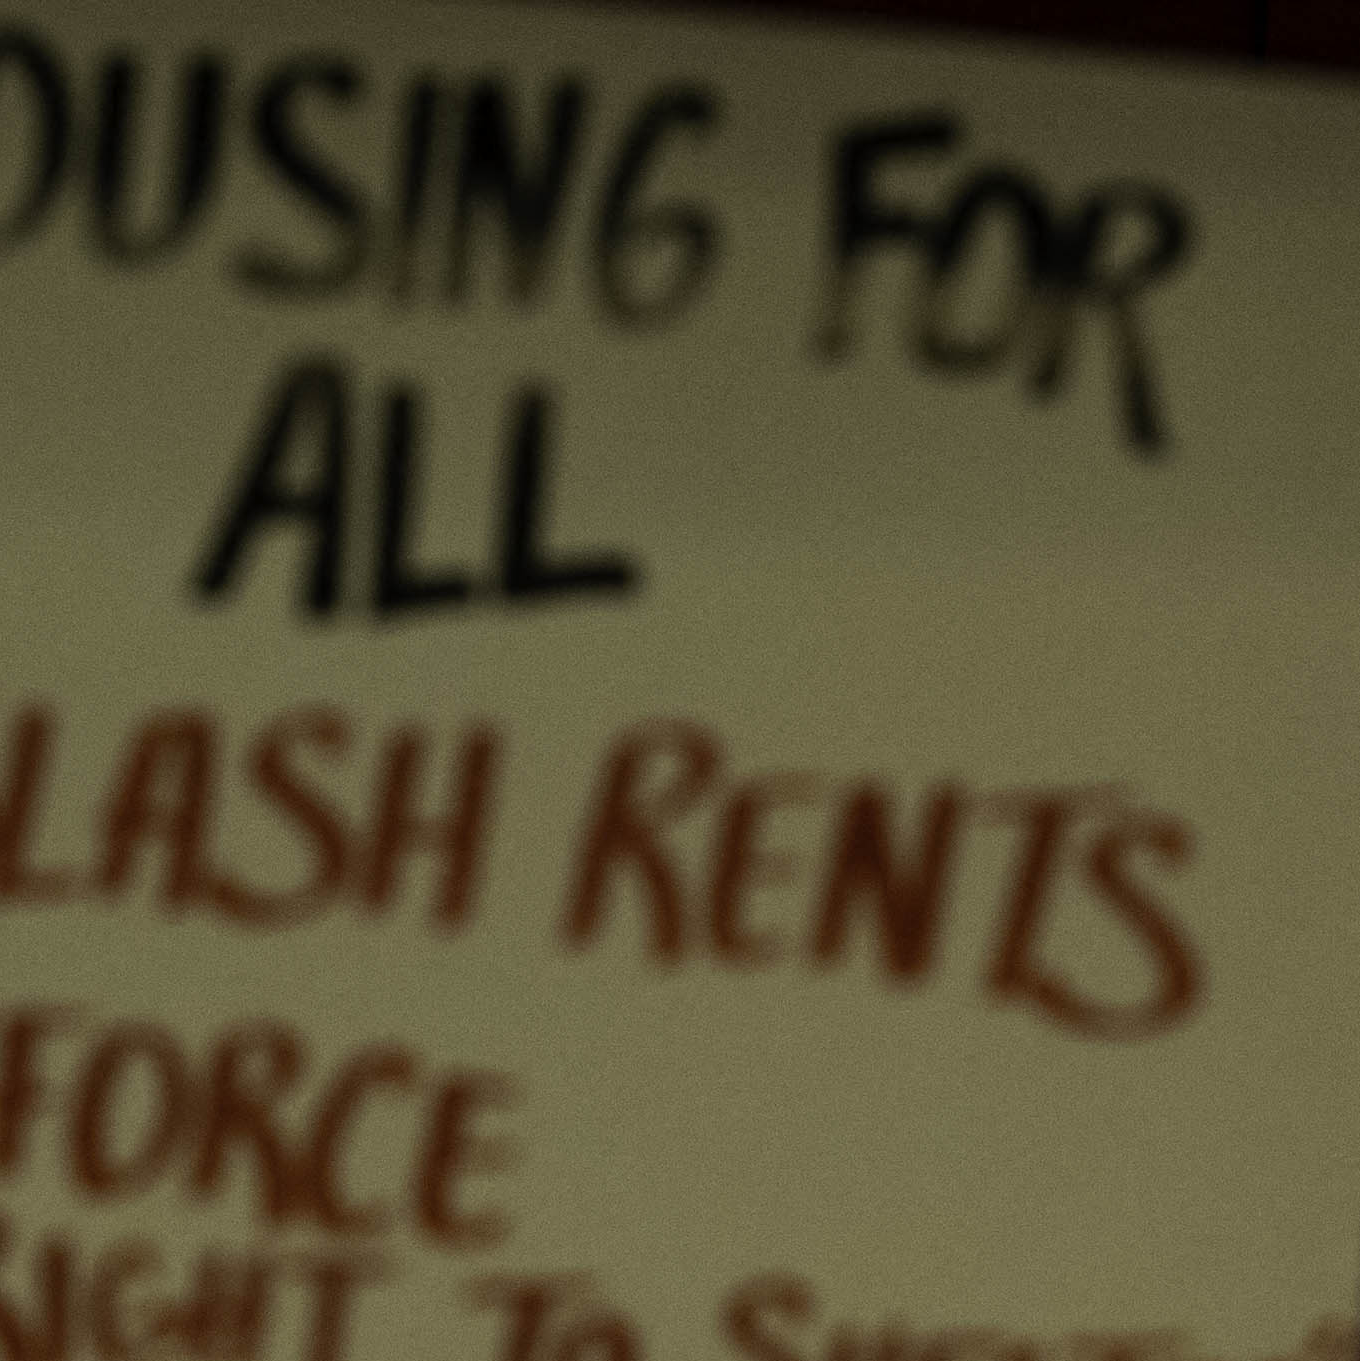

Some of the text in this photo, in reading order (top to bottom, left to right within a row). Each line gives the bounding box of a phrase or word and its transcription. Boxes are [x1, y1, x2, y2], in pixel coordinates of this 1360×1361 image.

[809, 102, 1200, 459] FOR
[189, 348, 642, 622] ALL
[560, 716, 1209, 1043] RENTS
